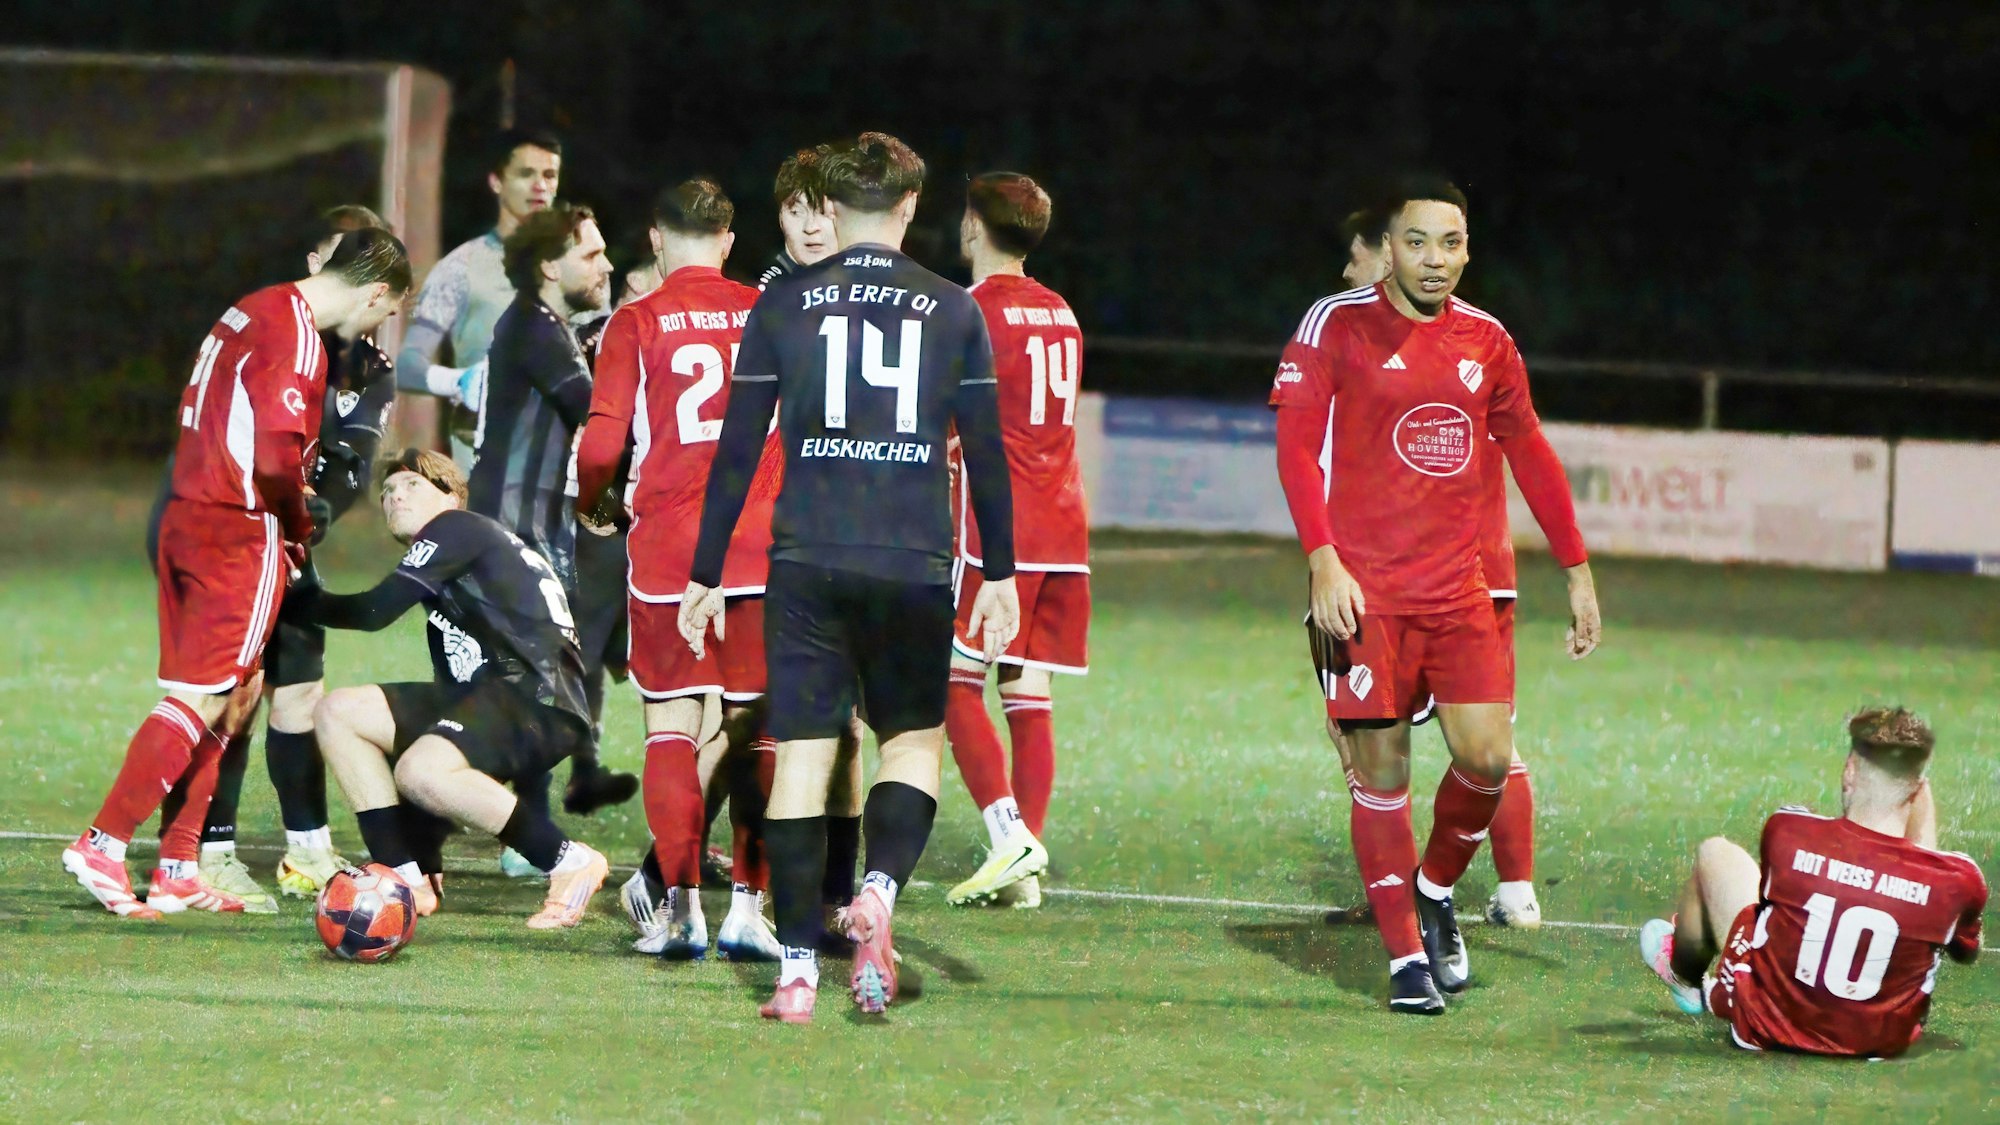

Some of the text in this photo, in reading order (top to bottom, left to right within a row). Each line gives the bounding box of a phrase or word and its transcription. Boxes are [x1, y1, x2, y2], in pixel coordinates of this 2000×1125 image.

[843, 257, 893, 268] JSG DNA
[802, 284, 840, 310] JSG
[849, 284, 908, 306] ERFT
[659, 311, 687, 333] ROT
[689, 310, 729, 330] WEISS
[818, 315, 923, 434] 14
[1025, 335, 1078, 426] 14
[800, 438, 931, 464] EUSKIRCHEN
[1408, 443, 1465, 455] HOVERHOF
[1417, 435, 1463, 446] SCHMITZ
[1792, 849, 1932, 906] ROT WEISS AHREM
[1794, 892, 1900, 1002] 10
